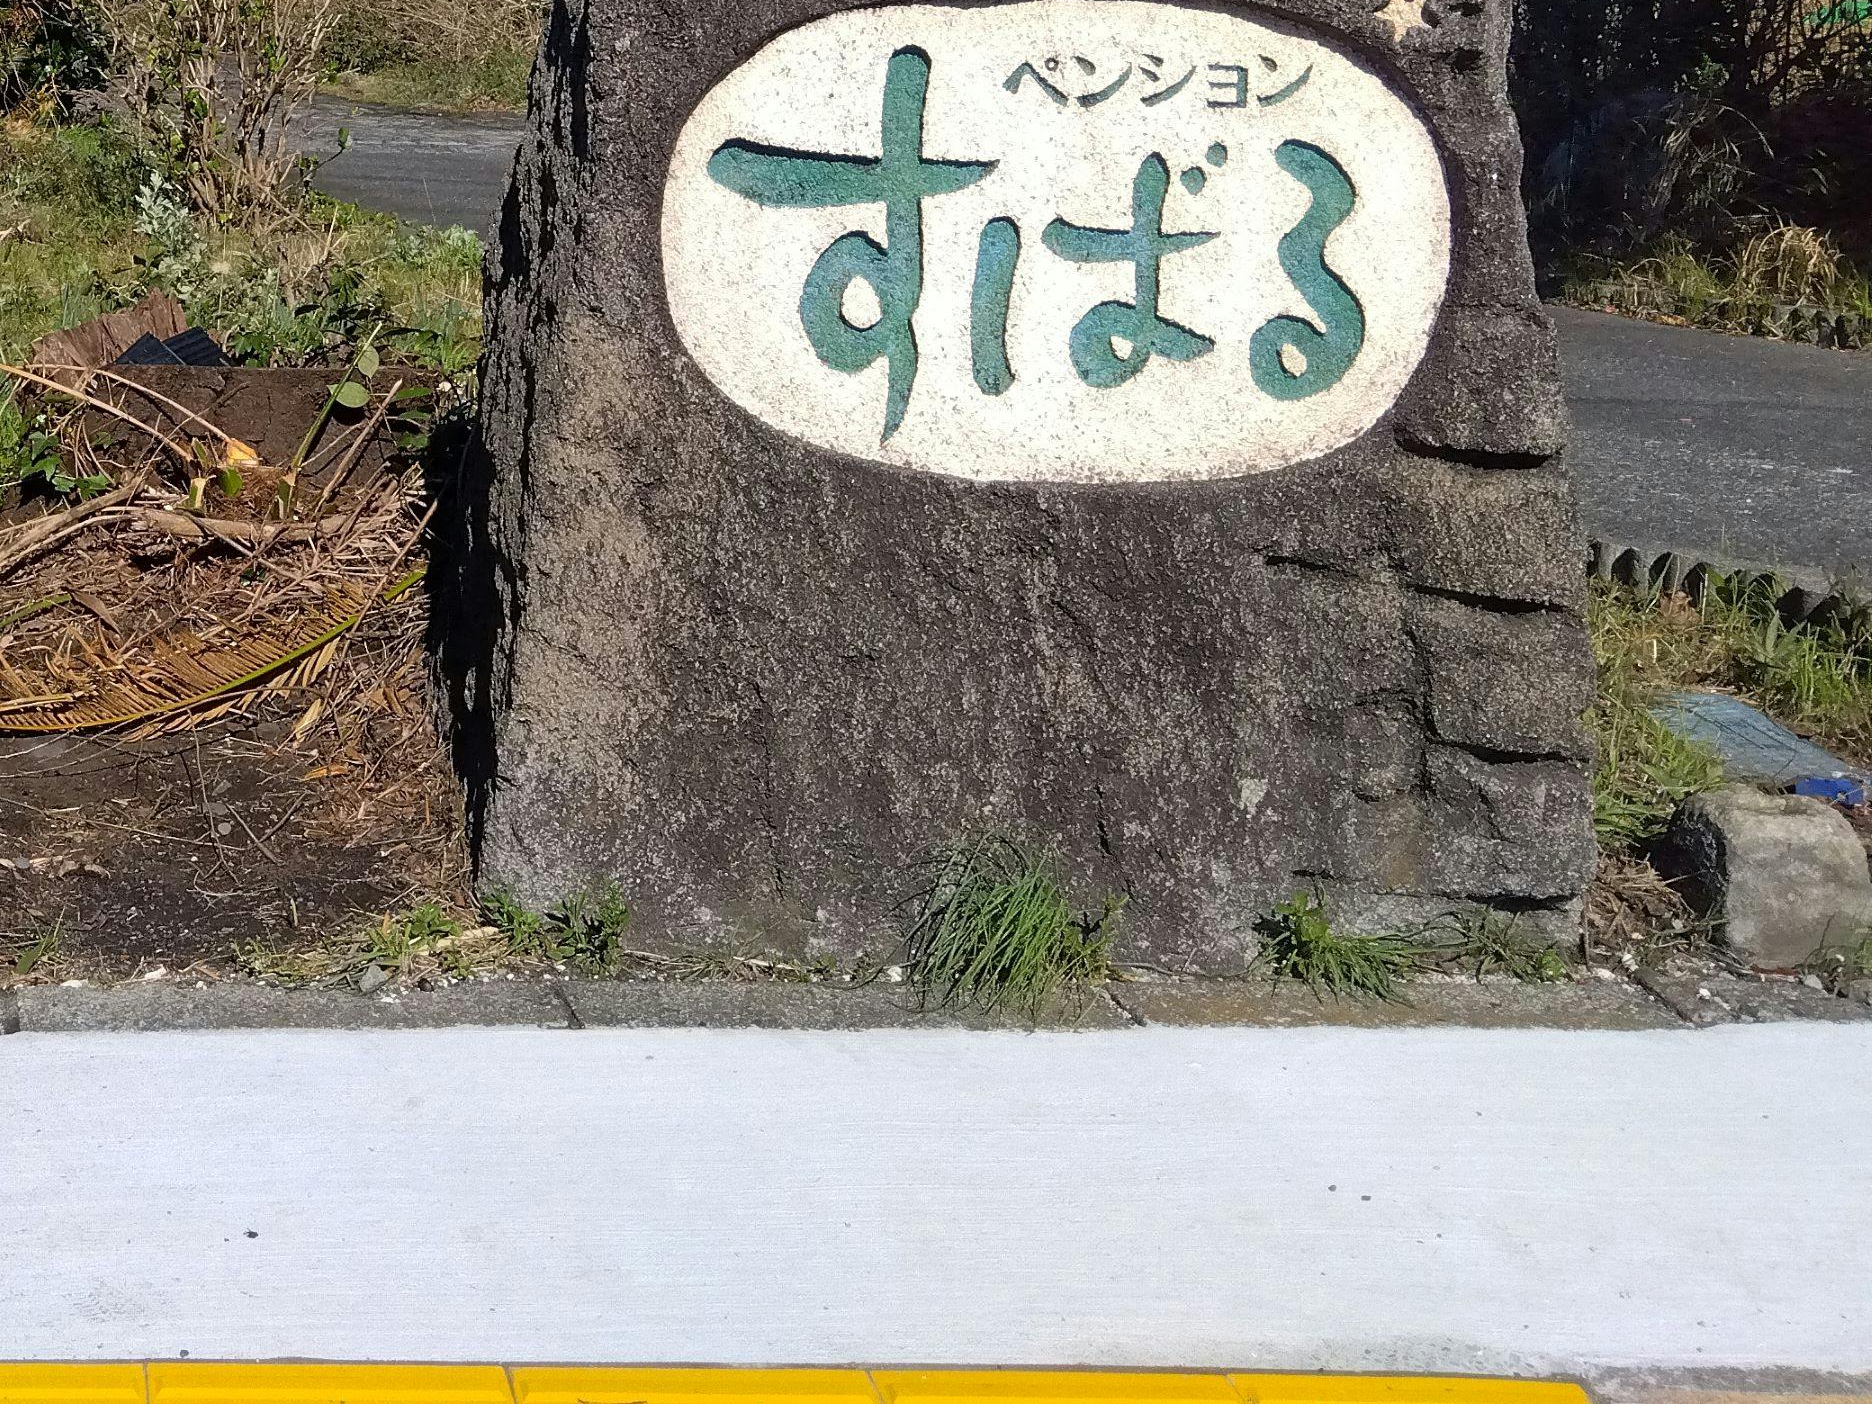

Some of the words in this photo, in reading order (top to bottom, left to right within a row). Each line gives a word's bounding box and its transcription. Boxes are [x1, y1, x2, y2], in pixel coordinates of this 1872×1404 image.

[1002, 53, 1314, 108] ペンション
[707, 45, 1366, 445] すばる
